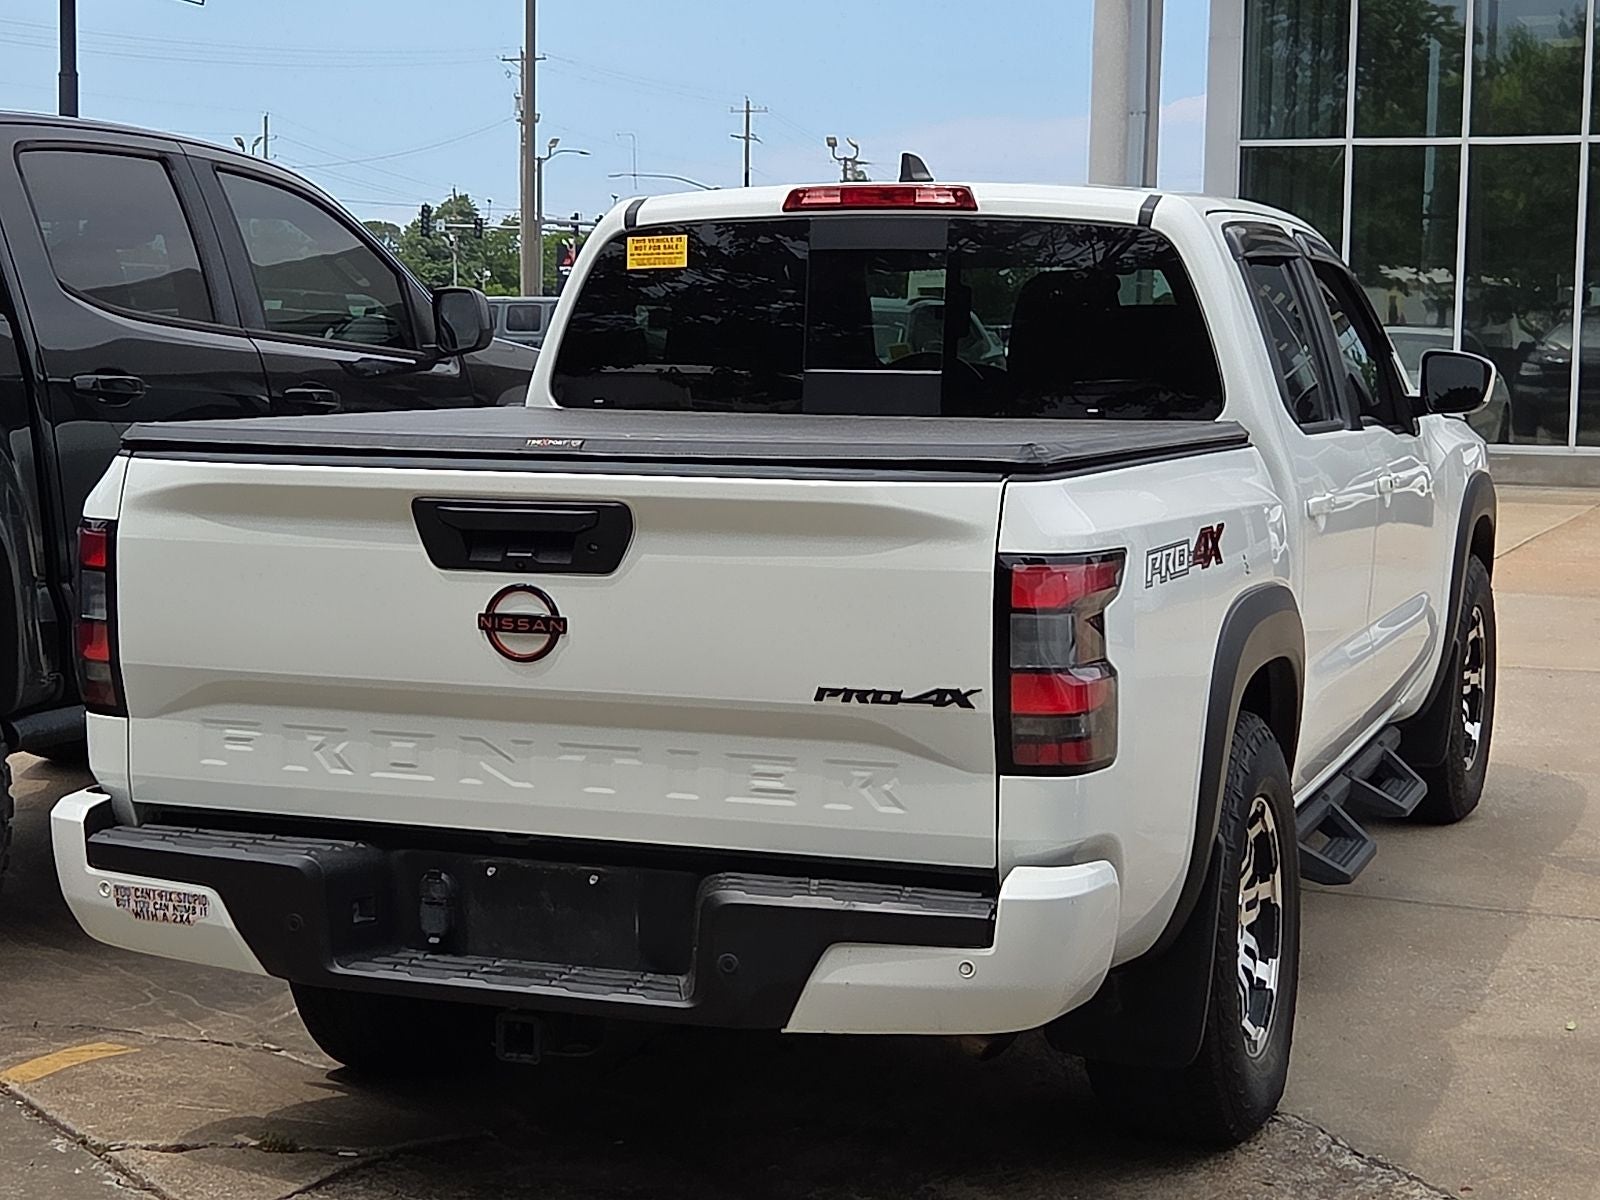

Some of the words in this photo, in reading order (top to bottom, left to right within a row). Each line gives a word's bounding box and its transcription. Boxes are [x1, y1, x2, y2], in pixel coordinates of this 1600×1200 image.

[1144, 522, 1225, 589] PRO-4X
[480, 615, 565, 632] NISSAN
[199, 717, 908, 815] FRONTIER
[113, 884, 132, 897] YOU
[158, 889, 174, 902] FIX
[115, 897, 130, 908] BUT
[134, 899, 150, 912] YOU
[152, 901, 170, 912] CAN
[172, 904, 197, 915] NUMB
[199, 905, 208, 917] IT
[132, 908, 159, 921] WITH
[162, 912, 169, 922] A
